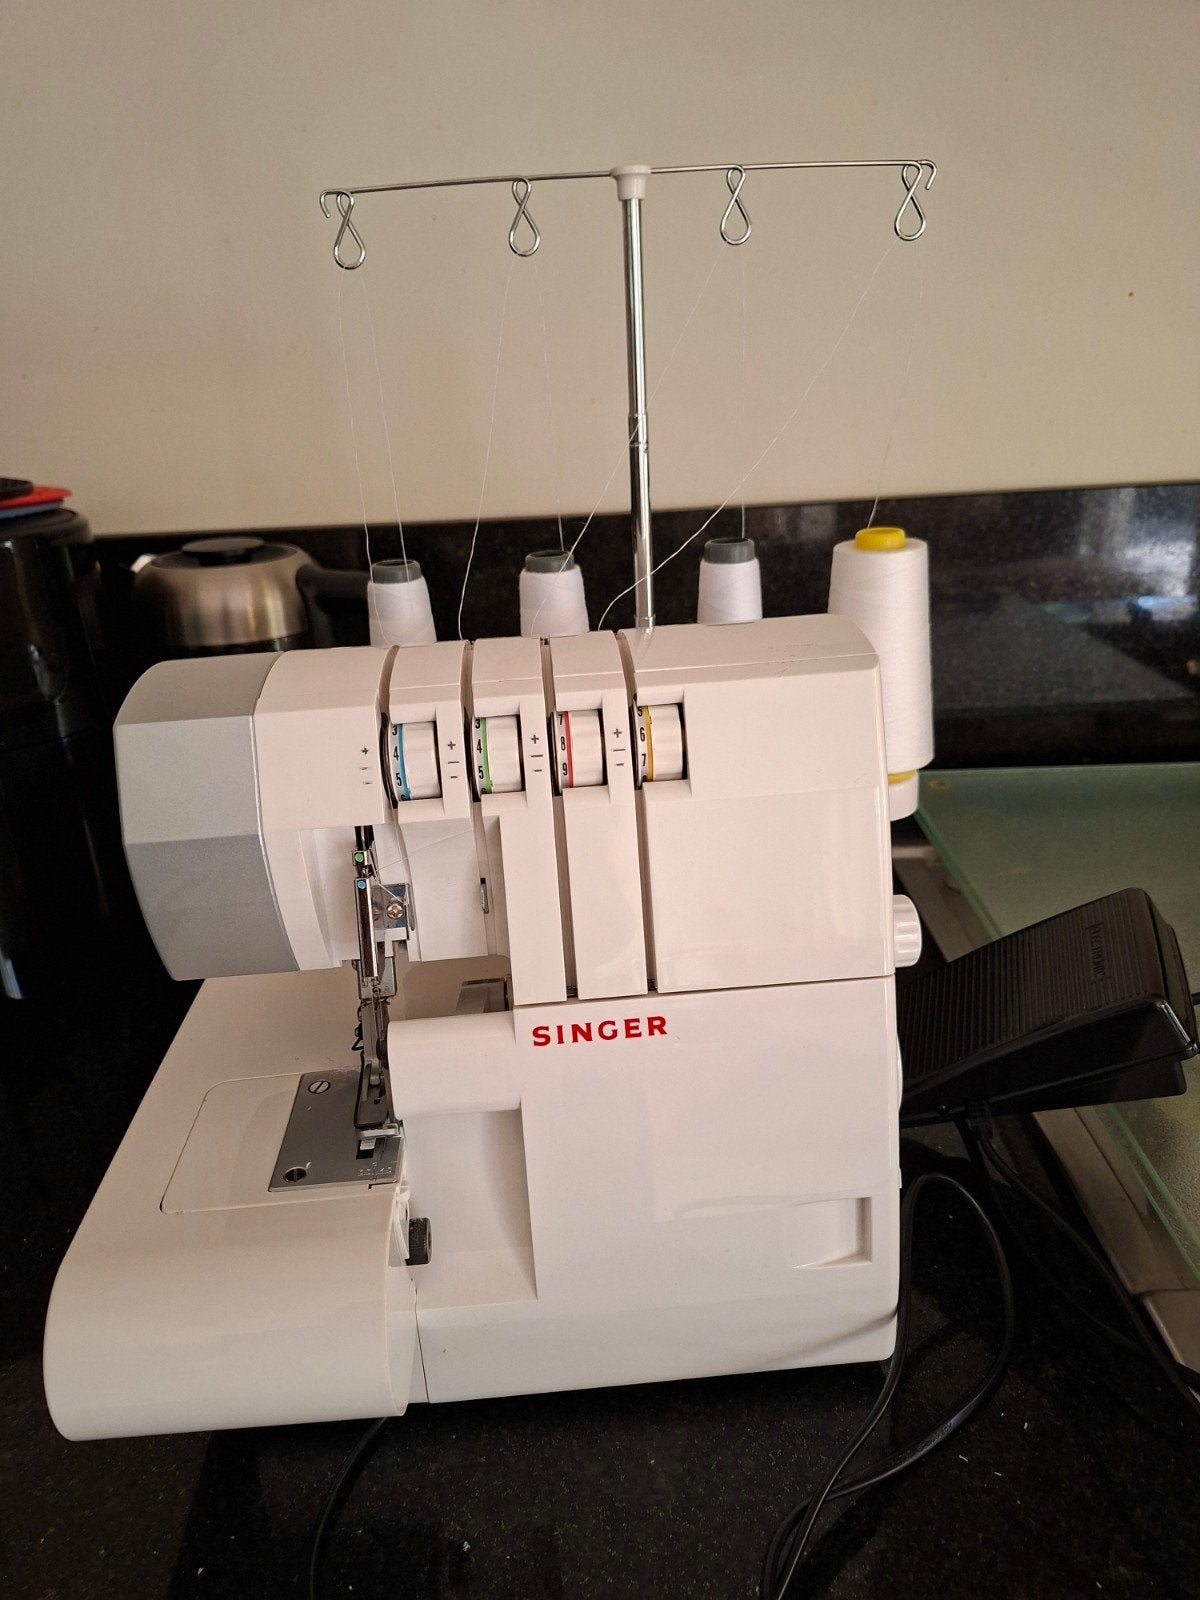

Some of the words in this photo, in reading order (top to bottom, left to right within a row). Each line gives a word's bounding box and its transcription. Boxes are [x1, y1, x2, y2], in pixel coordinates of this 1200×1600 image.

[475, 718, 481, 729] 3
[558, 714, 563, 725] 7
[392, 724, 398, 736] 3
[639, 727, 646, 742] 6
[476, 739, 482, 753] 4
[560, 736, 566, 751] 8
[393, 746, 400, 760] 4
[641, 753, 647, 767] 7
[478, 765, 484, 779] 5
[562, 762, 568, 776] 9
[395, 772, 402, 787] 5
[532, 1016, 668, 1047] SINGER
